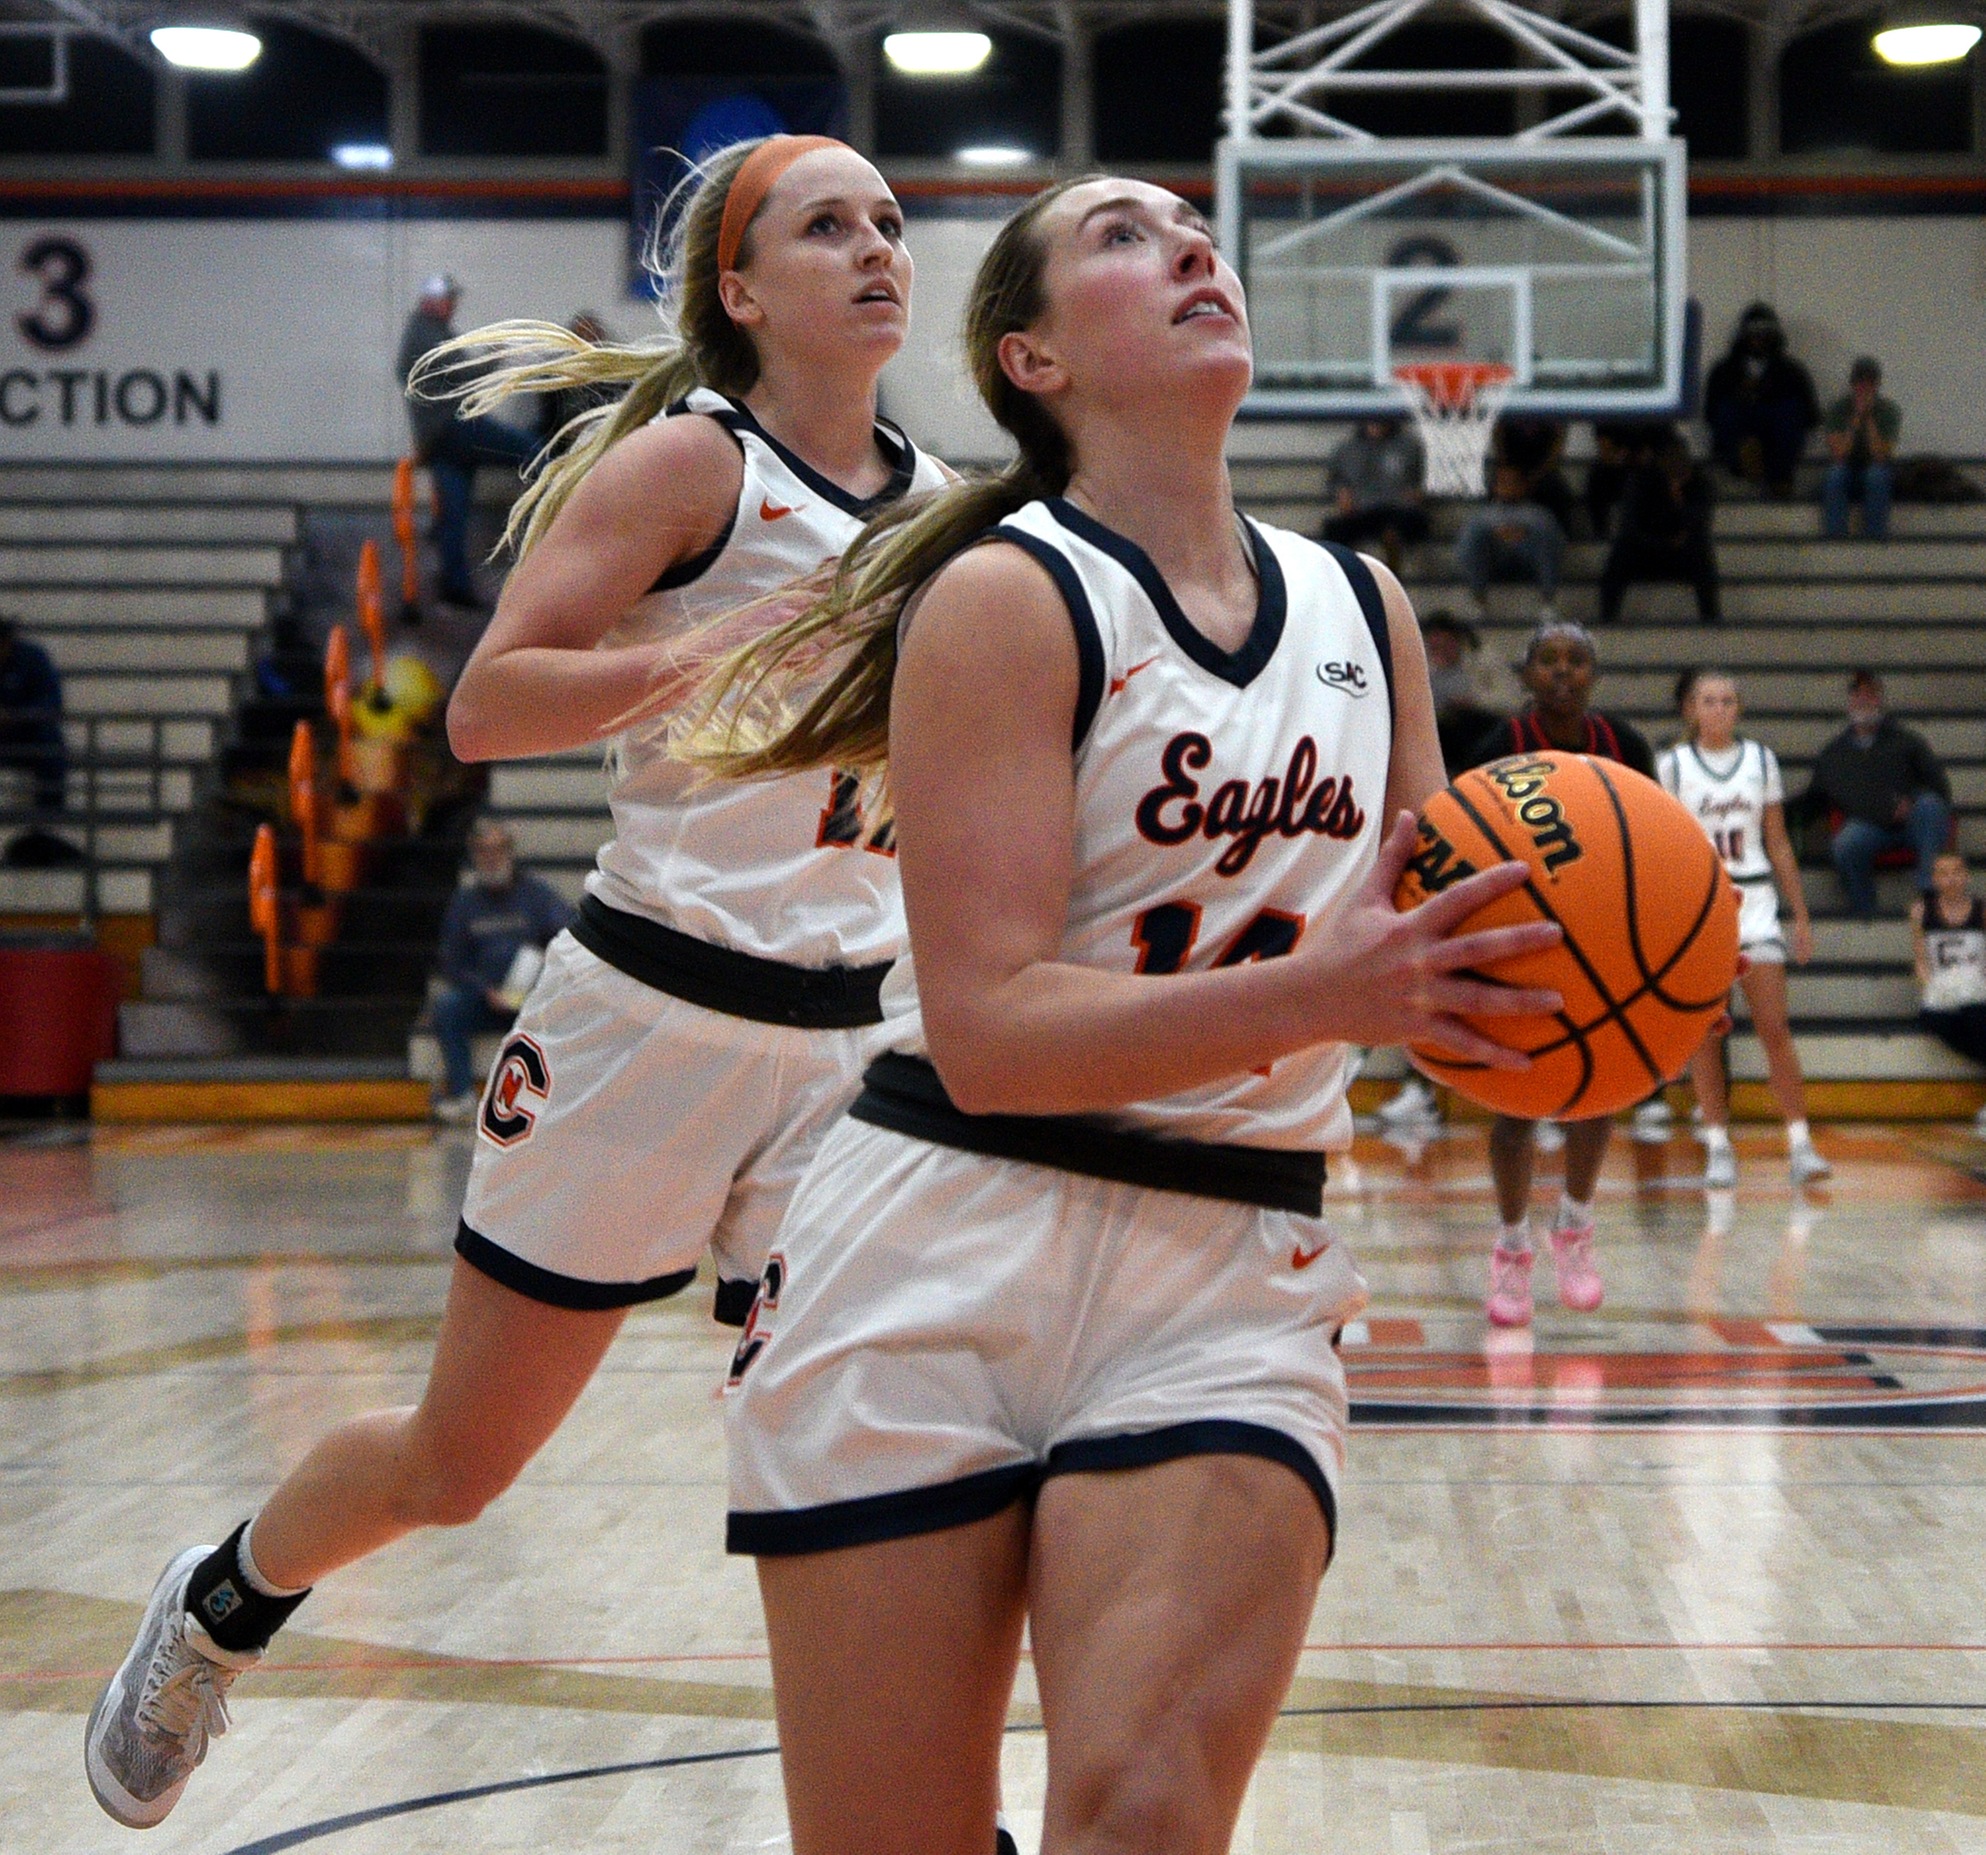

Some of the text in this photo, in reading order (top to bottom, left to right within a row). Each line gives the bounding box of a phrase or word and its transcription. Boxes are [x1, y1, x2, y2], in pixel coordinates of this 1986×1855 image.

[17, 236, 95, 350] 3
[1386, 236, 1461, 350] 2
[1135, 731, 1365, 878] Eagles
